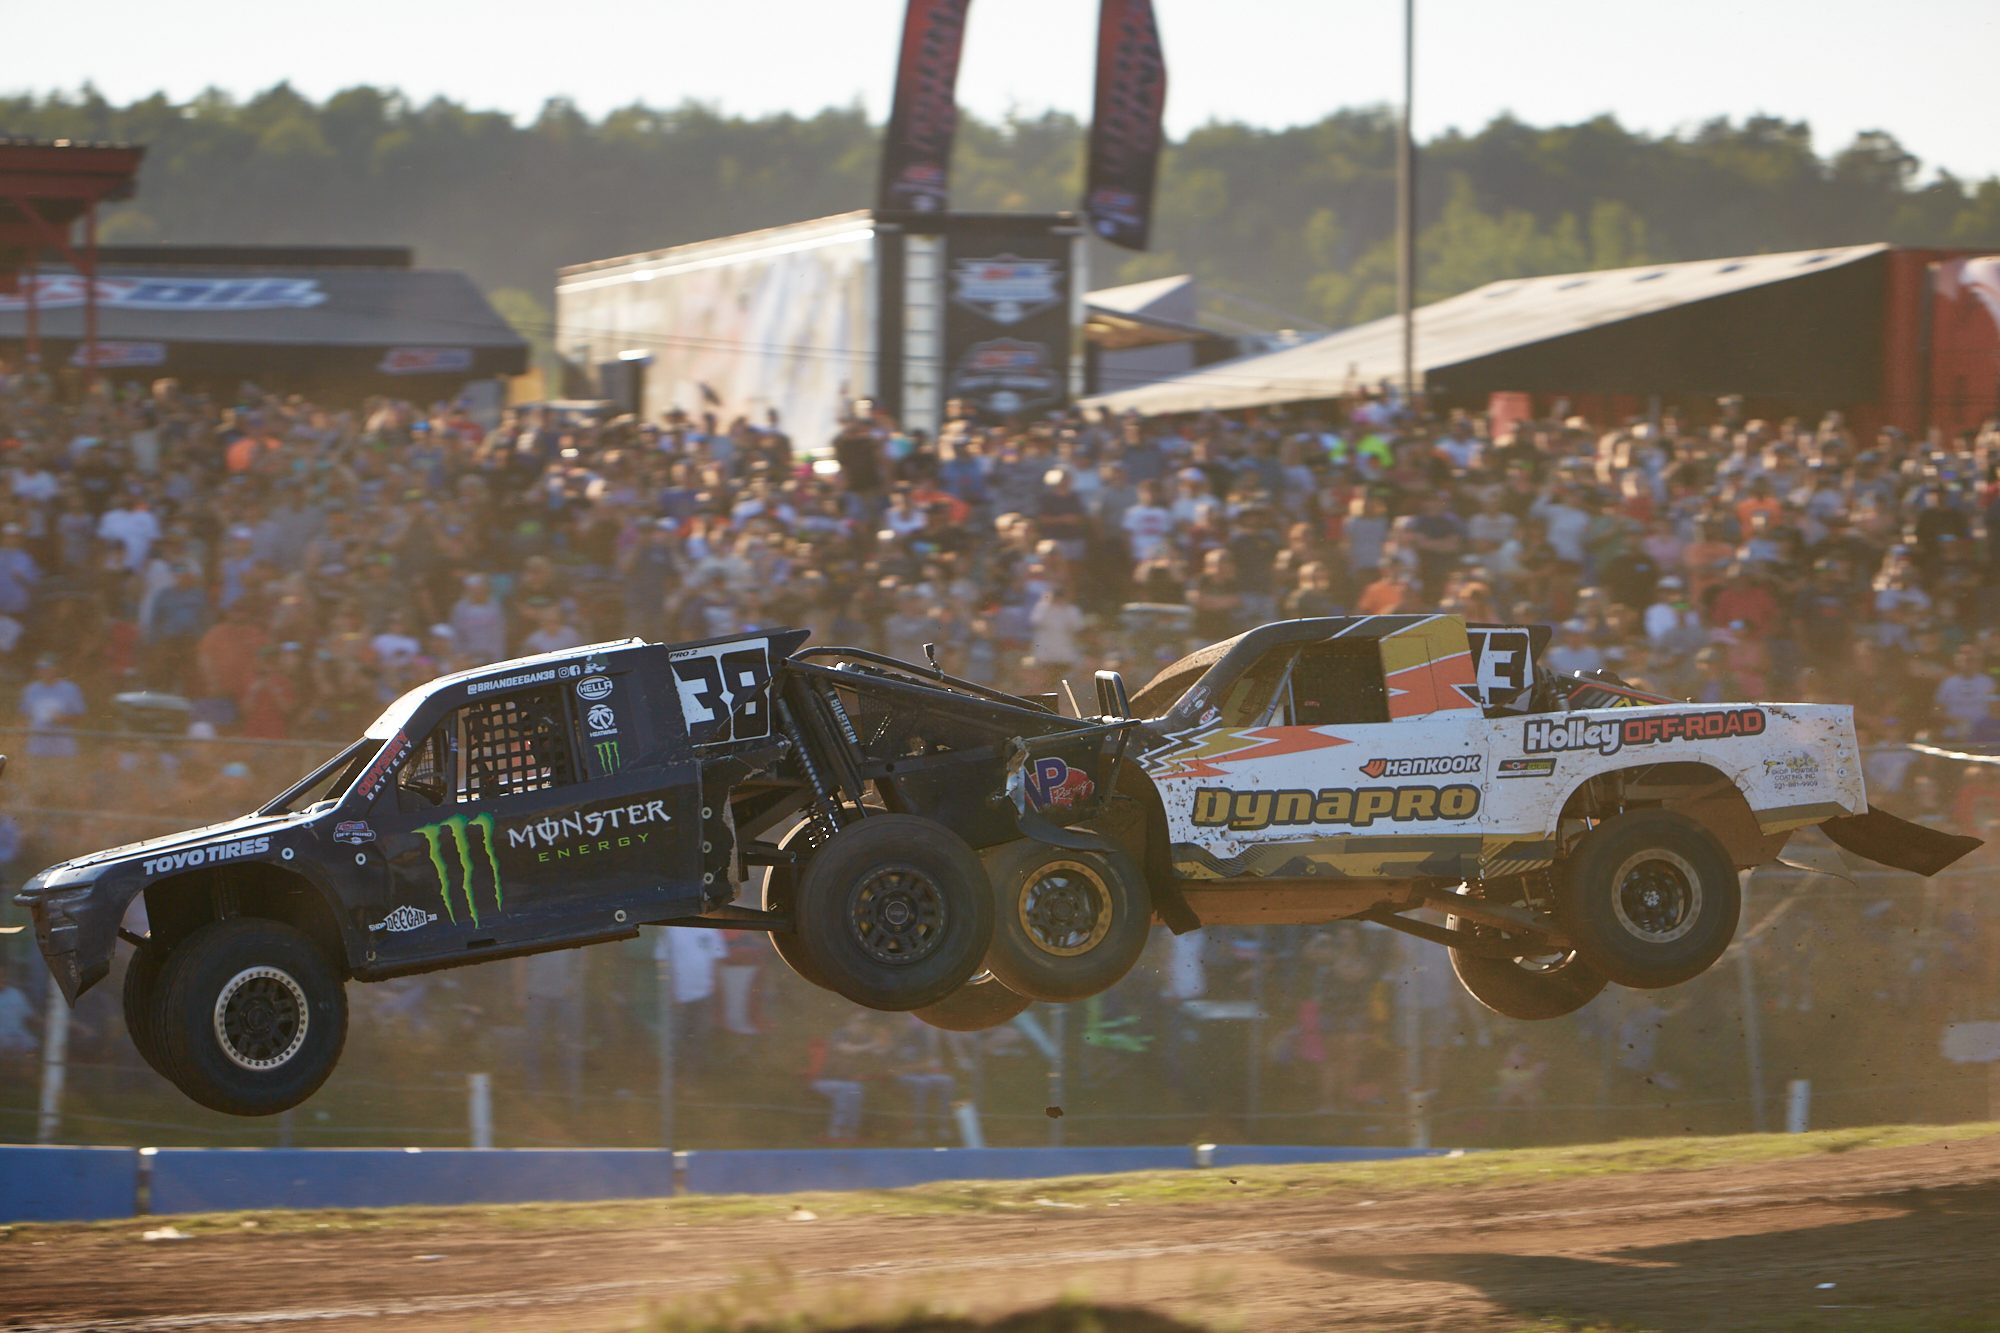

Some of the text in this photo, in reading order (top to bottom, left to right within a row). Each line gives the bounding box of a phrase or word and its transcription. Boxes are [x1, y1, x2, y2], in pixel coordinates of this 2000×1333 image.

[669, 650, 690, 659] PRO
[467, 670, 555, 695] @BRIANDEEGAN38
[579, 680, 614, 694] HELLA
[671, 648, 772, 744] 38
[831, 698, 860, 745] BILSTEIN
[1527, 710, 1763, 754] Holley OFF-ROAD
[357, 730, 408, 796] ODYSSEY
[367, 741, 412, 801] BATTERY
[1023, 756, 1069, 812] VP
[506, 800, 672, 849] MONSTER
[143, 836, 271, 875] TOYO TIRES
[538, 833, 649, 862] ENERGY
[385, 906, 426, 931] DEEGAN
